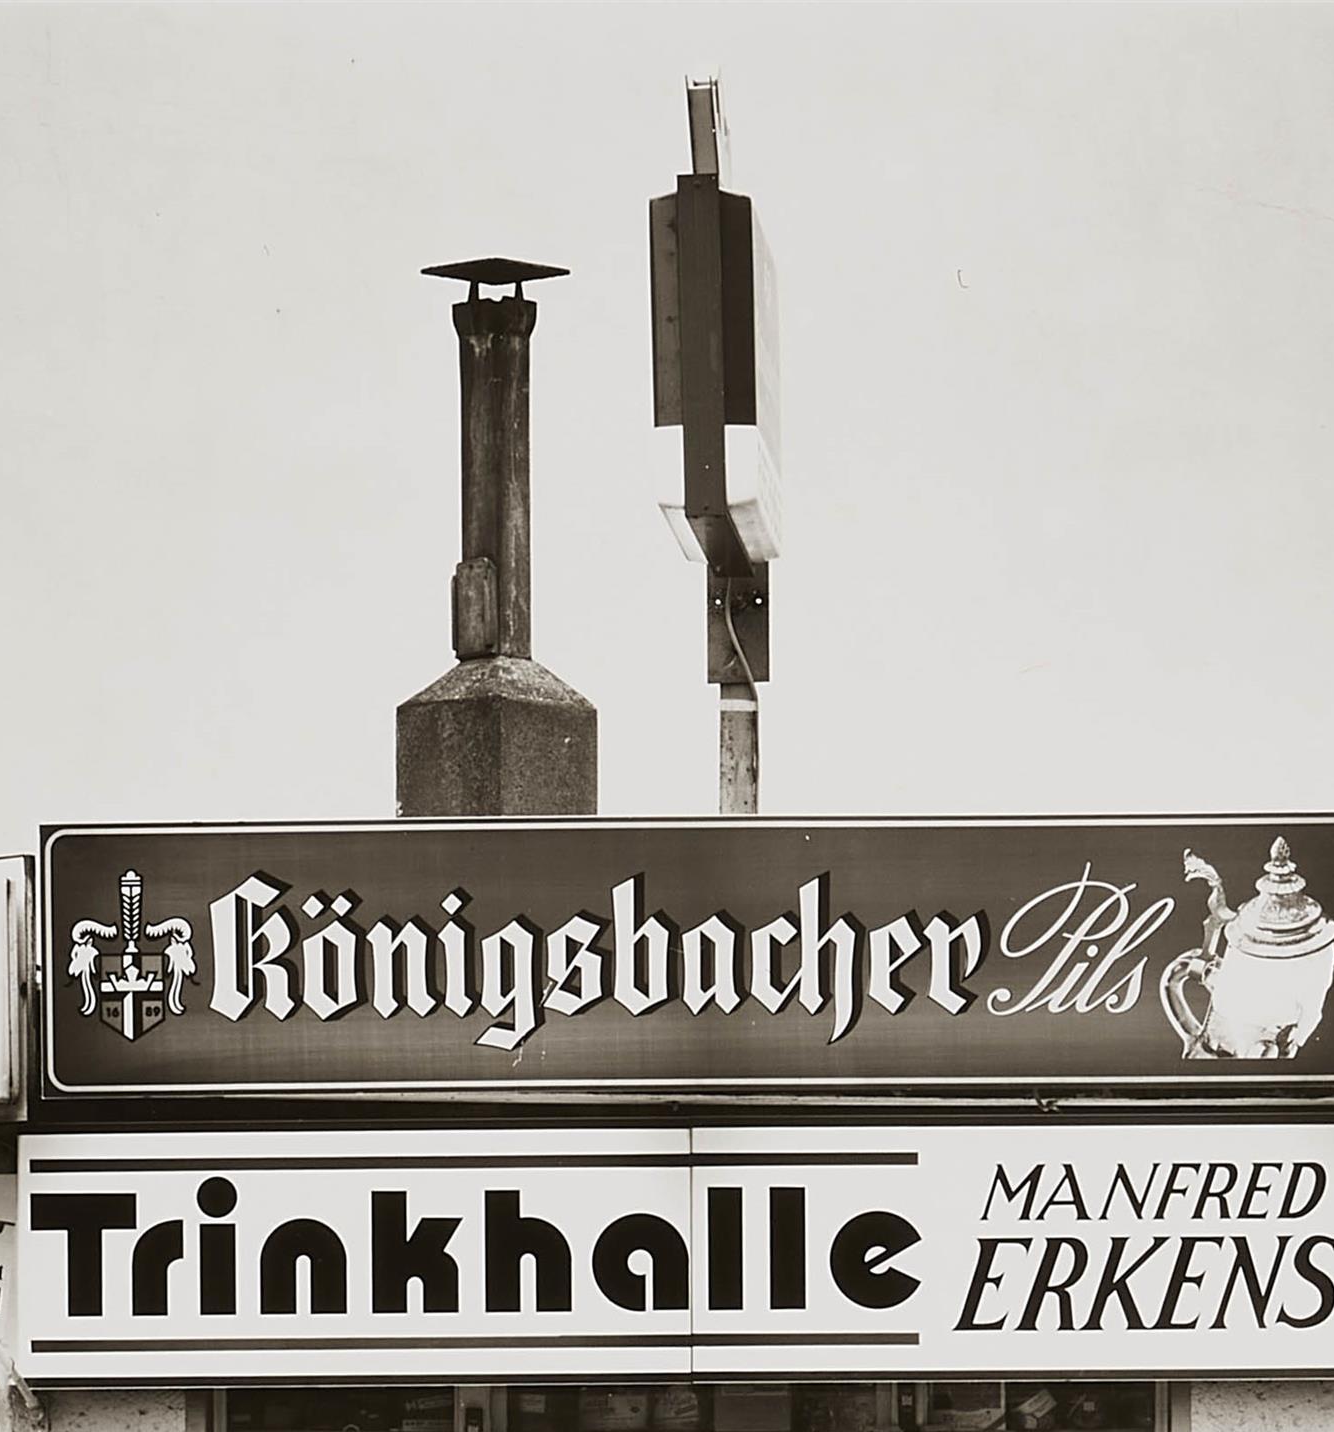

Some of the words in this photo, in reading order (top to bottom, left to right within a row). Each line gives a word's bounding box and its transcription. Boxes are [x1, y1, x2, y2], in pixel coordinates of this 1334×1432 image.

[207, 868, 985, 1052] Königsbacher
[985, 860, 1181, 1018] Pils
[28, 1176, 922, 1318] Trinkhalle
[979, 1160, 1329, 1223] MANFRED
